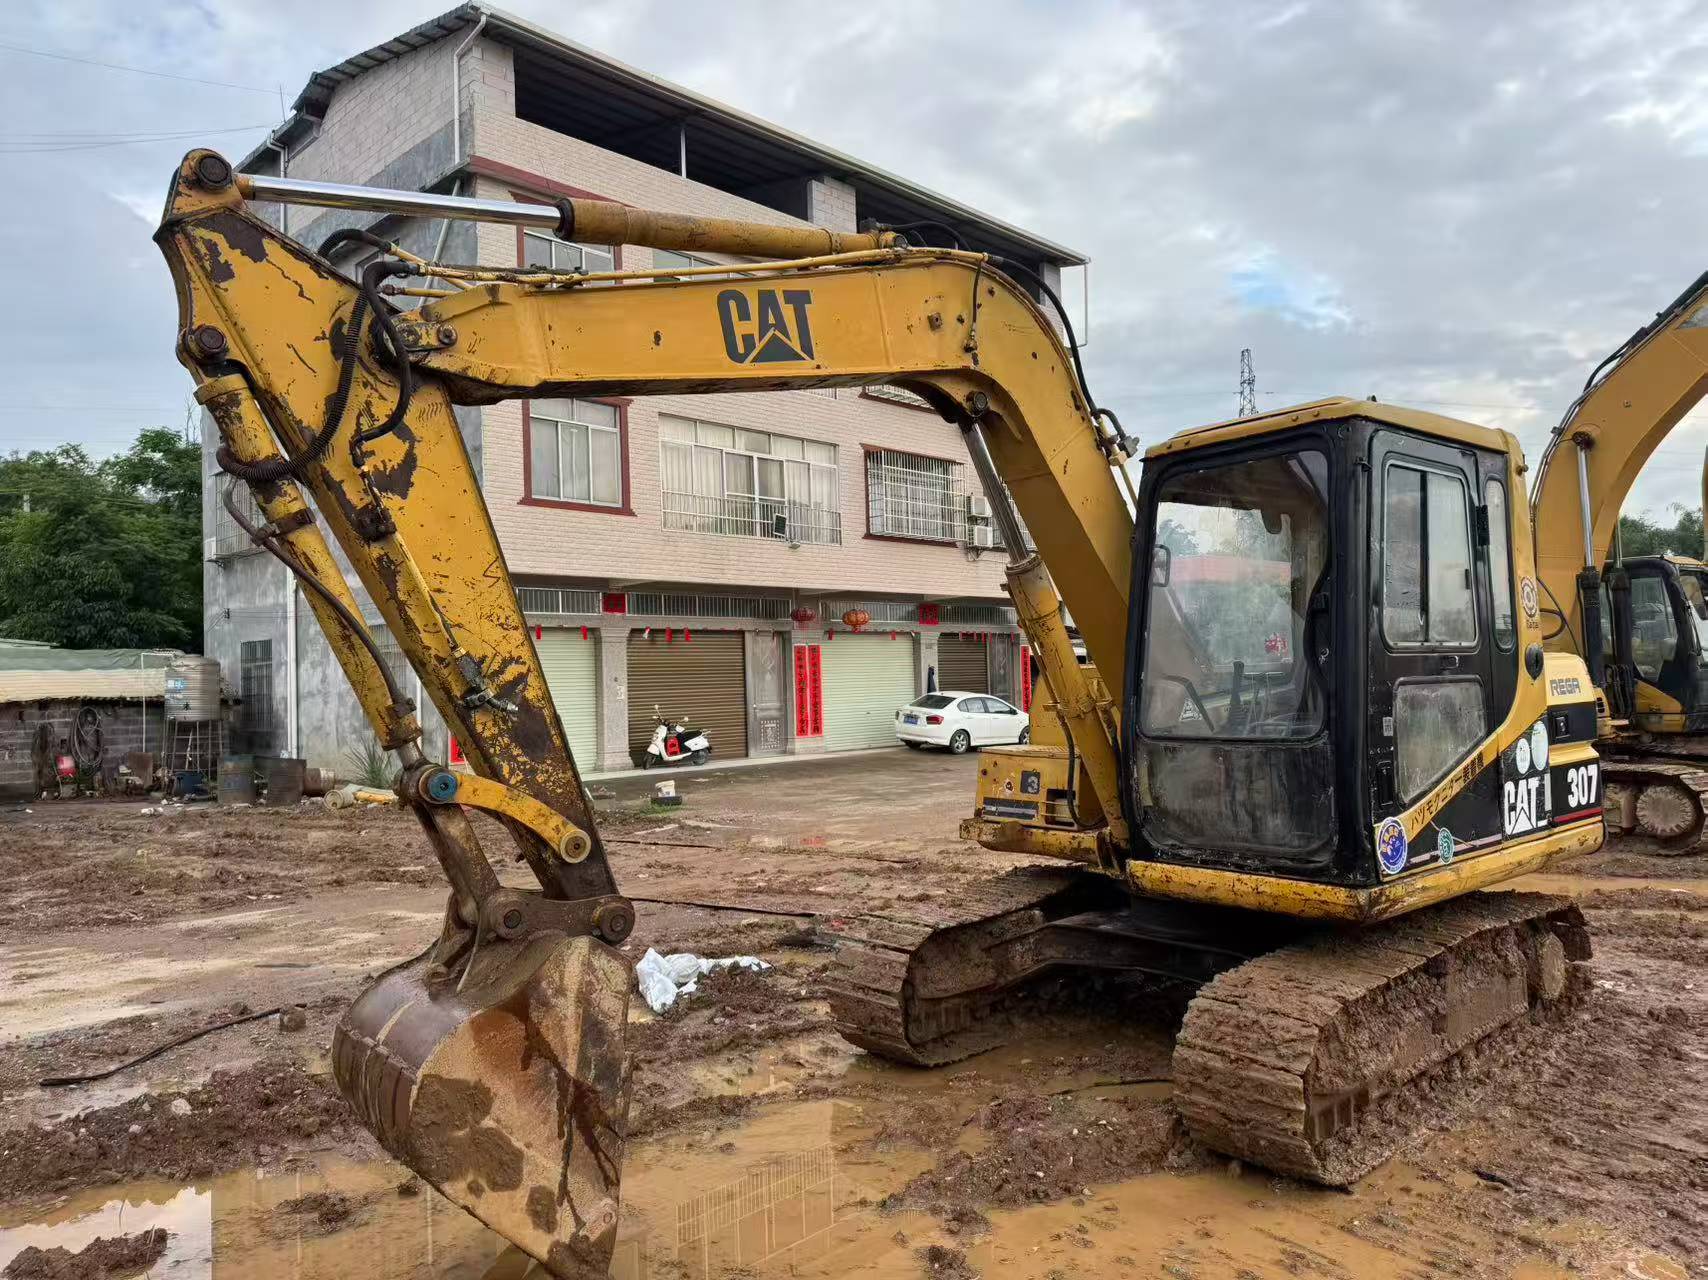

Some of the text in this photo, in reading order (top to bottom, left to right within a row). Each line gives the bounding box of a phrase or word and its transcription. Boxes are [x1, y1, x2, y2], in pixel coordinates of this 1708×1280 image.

[716, 288, 815, 364] CAT
[1503, 776, 1540, 836] CAT
[1567, 763, 1598, 808] 307
